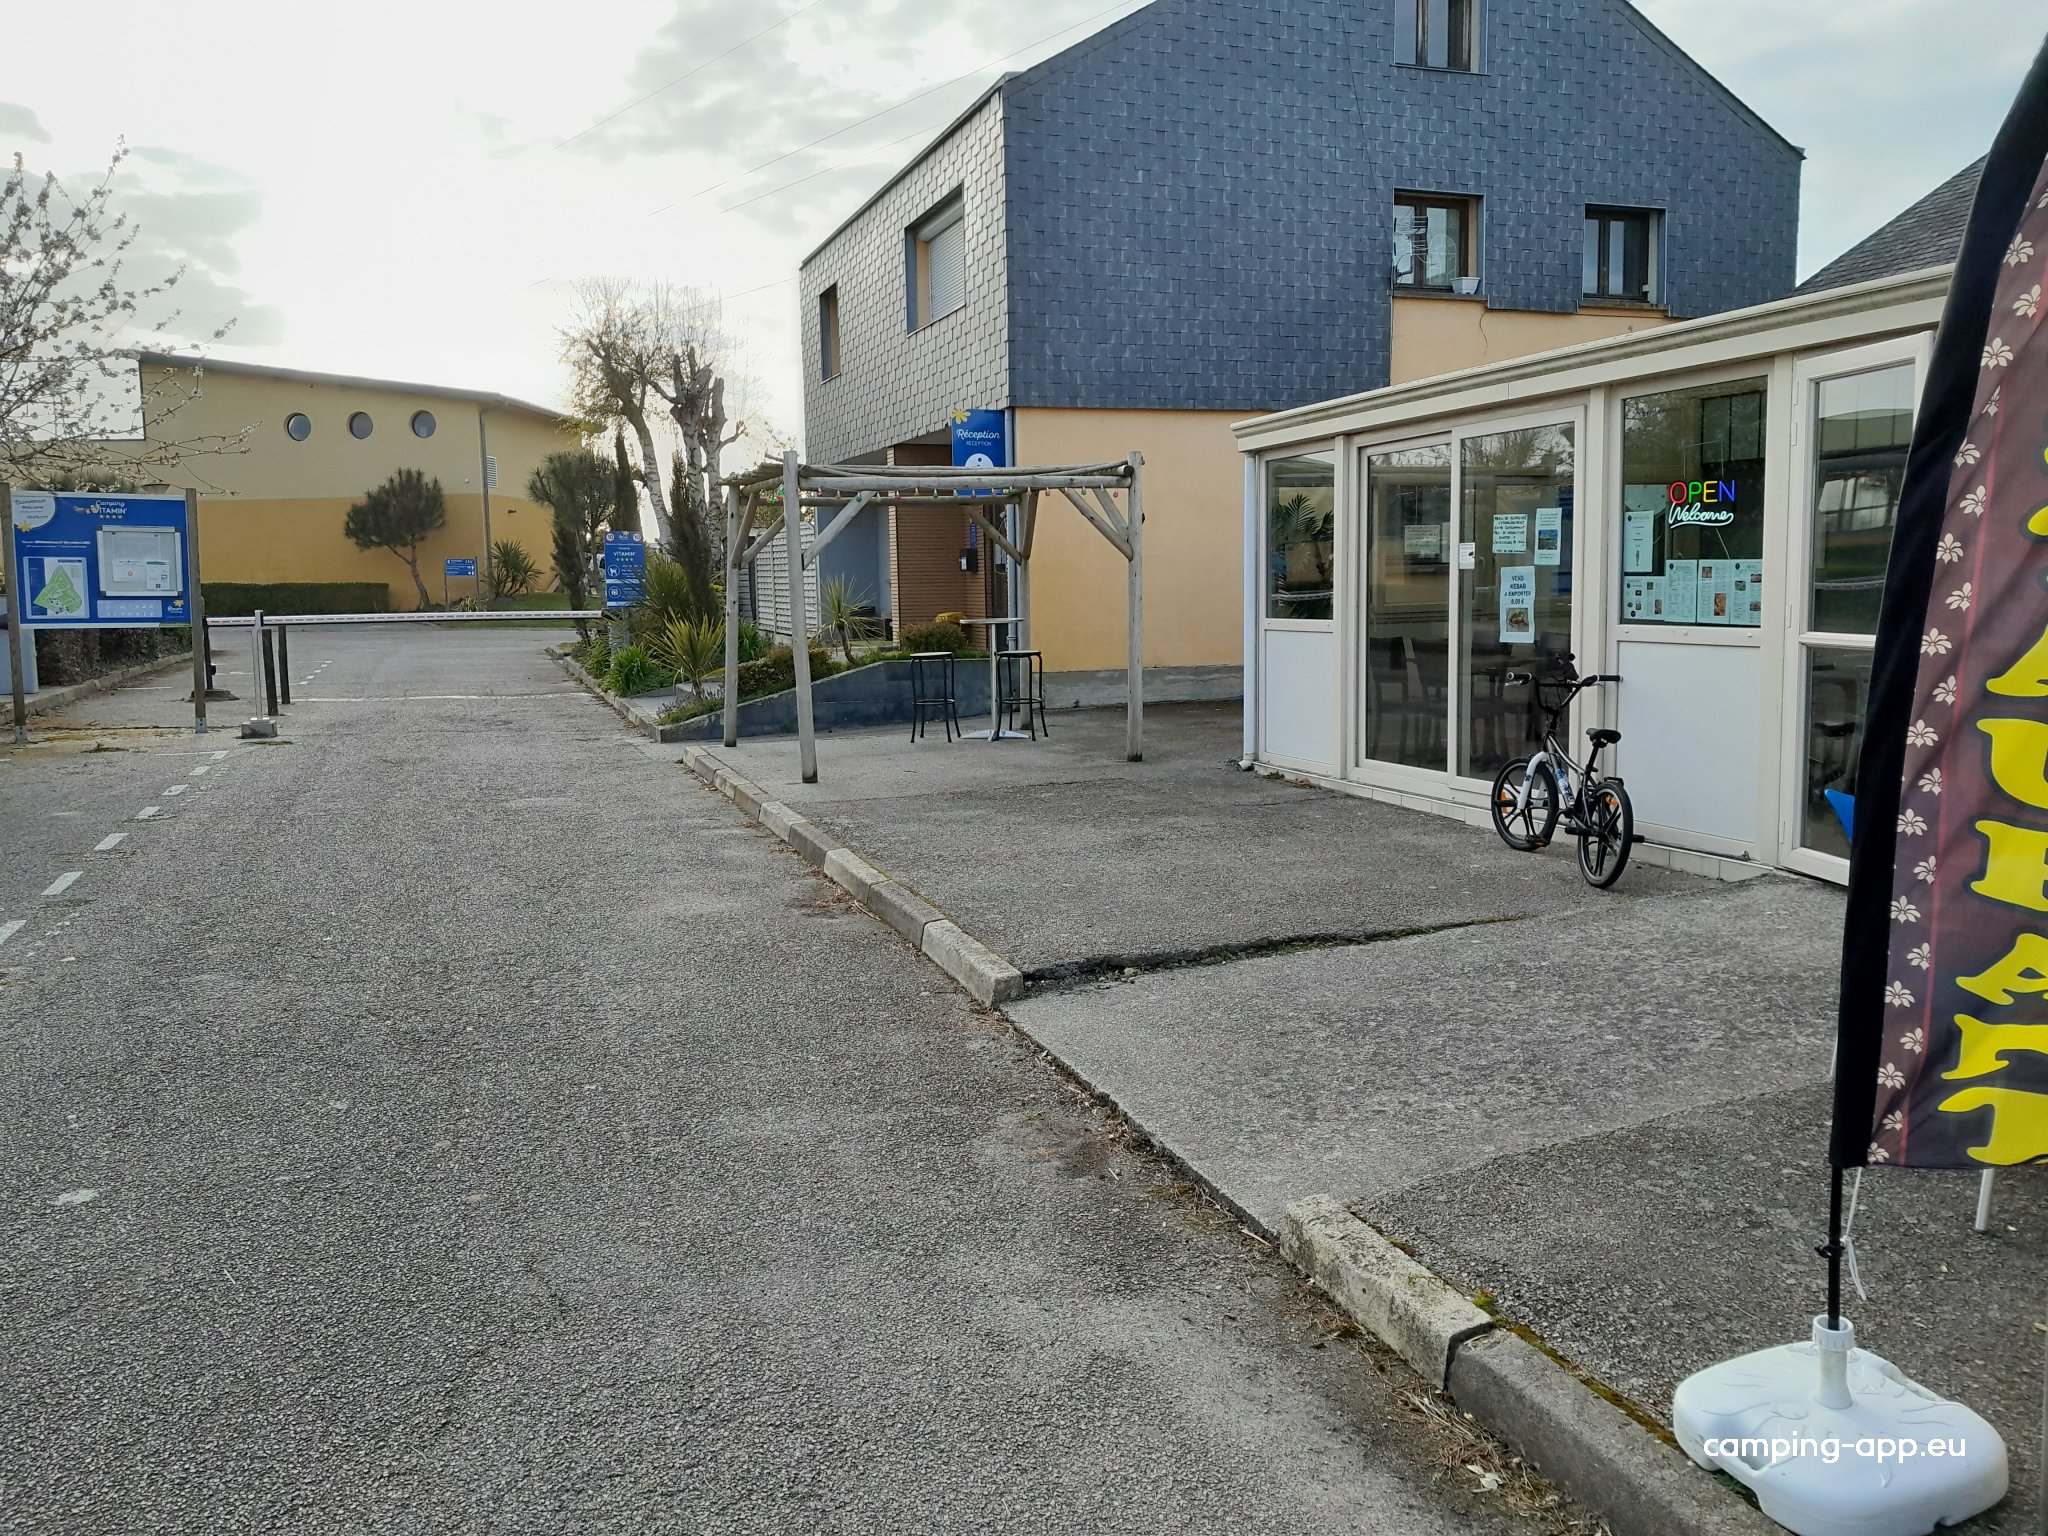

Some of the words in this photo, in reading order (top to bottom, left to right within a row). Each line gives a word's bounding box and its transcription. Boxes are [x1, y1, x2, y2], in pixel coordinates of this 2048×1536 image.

[957, 429, 1000, 440] Réception
[1669, 480, 1735, 504] OPEN
[96, 500, 125, 508] Camping
[1668, 502, 1734, 529] Welcome
